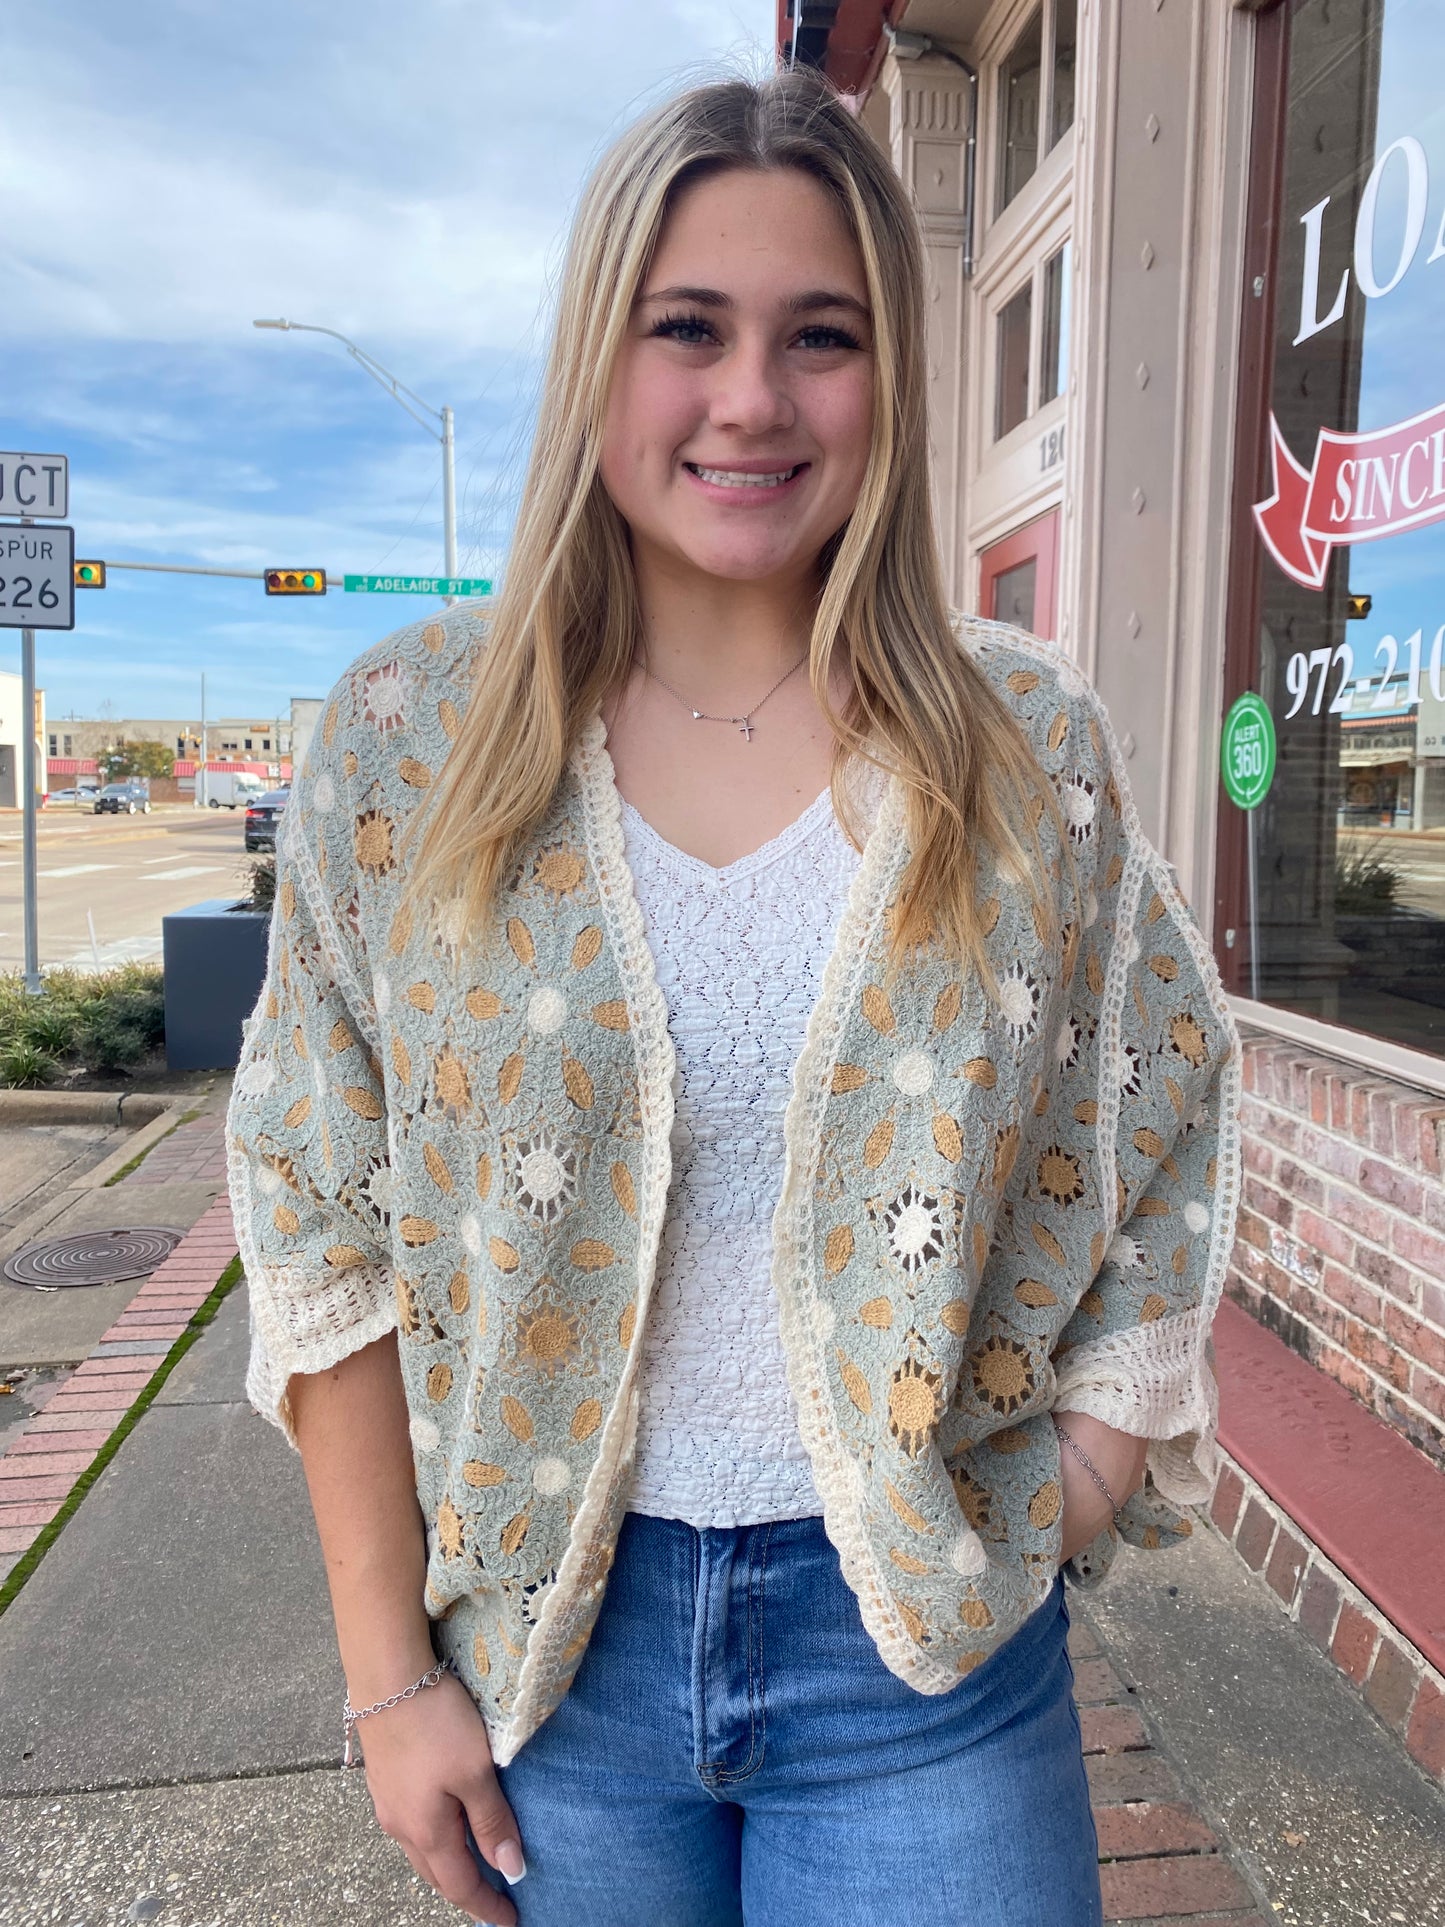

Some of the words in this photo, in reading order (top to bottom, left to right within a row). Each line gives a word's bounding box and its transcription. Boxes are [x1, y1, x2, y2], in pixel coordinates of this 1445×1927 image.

[0, 464, 62, 507] CT
[374, 578, 439, 593] ADELAIDE
[447, 580, 464, 593] ST
[1234, 723, 1260, 743] ALERT
[1233, 741, 1262, 779] 360
